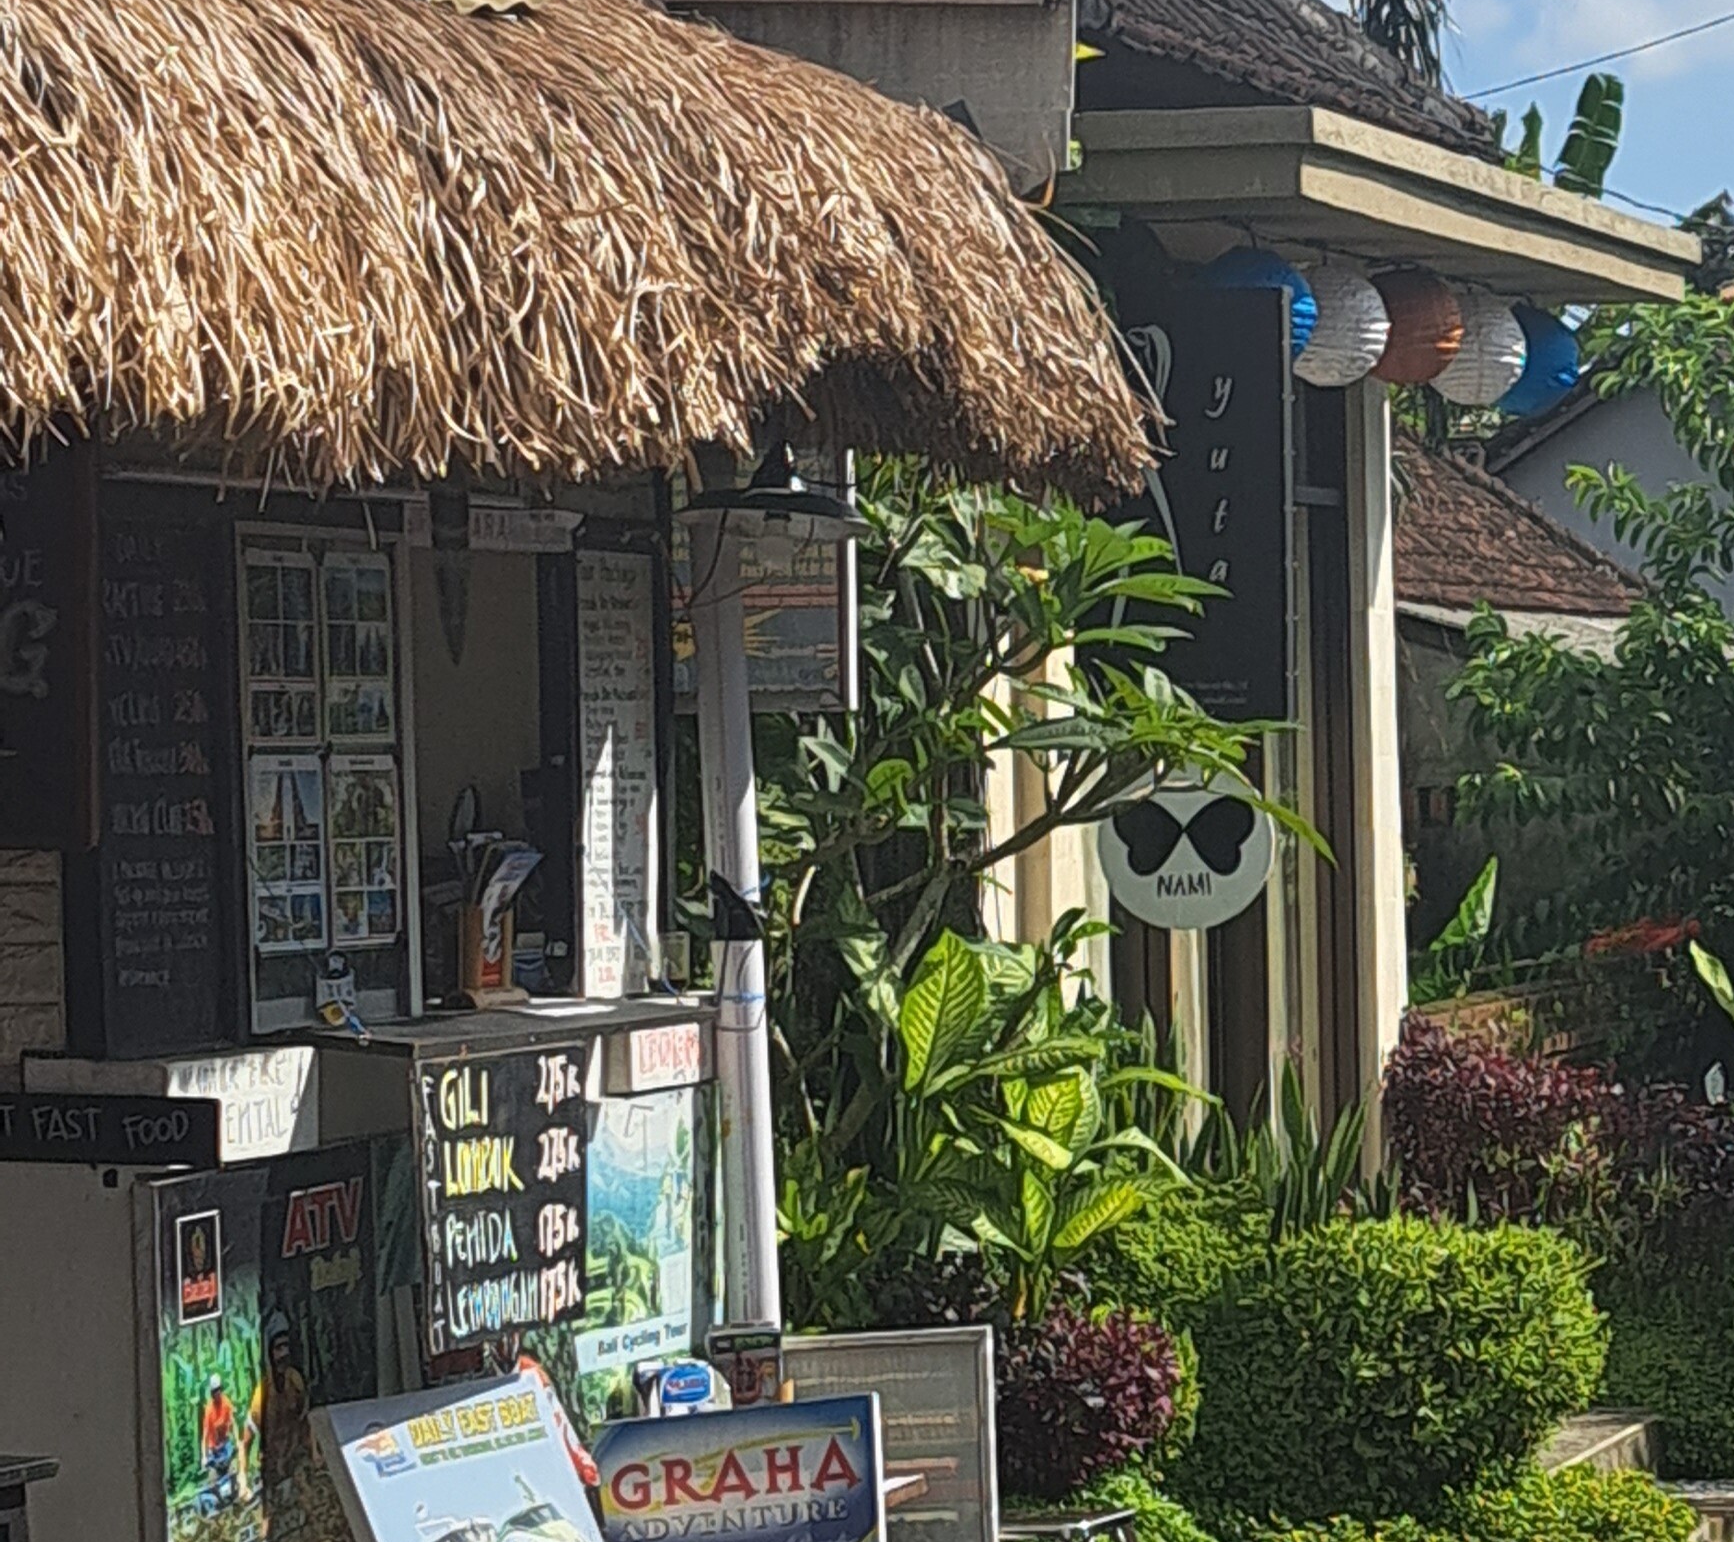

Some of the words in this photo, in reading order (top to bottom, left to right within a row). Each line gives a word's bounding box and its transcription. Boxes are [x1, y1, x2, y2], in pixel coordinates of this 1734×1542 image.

[1157, 871, 1212, 898] NAMI
[31, 1105, 102, 1142] FAST
[122, 1109, 190, 1150] FOOD
[226, 1095, 288, 1144] ENTAL
[281, 1174, 366, 1260] ATV
[597, 1335, 619, 1356] Bali
[622, 1329, 661, 1352] Cycling
[663, 1323, 688, 1340] Tour
[610, 1434, 862, 1510] GRAHA
[618, 1496, 849, 1542] ADVENTURE
